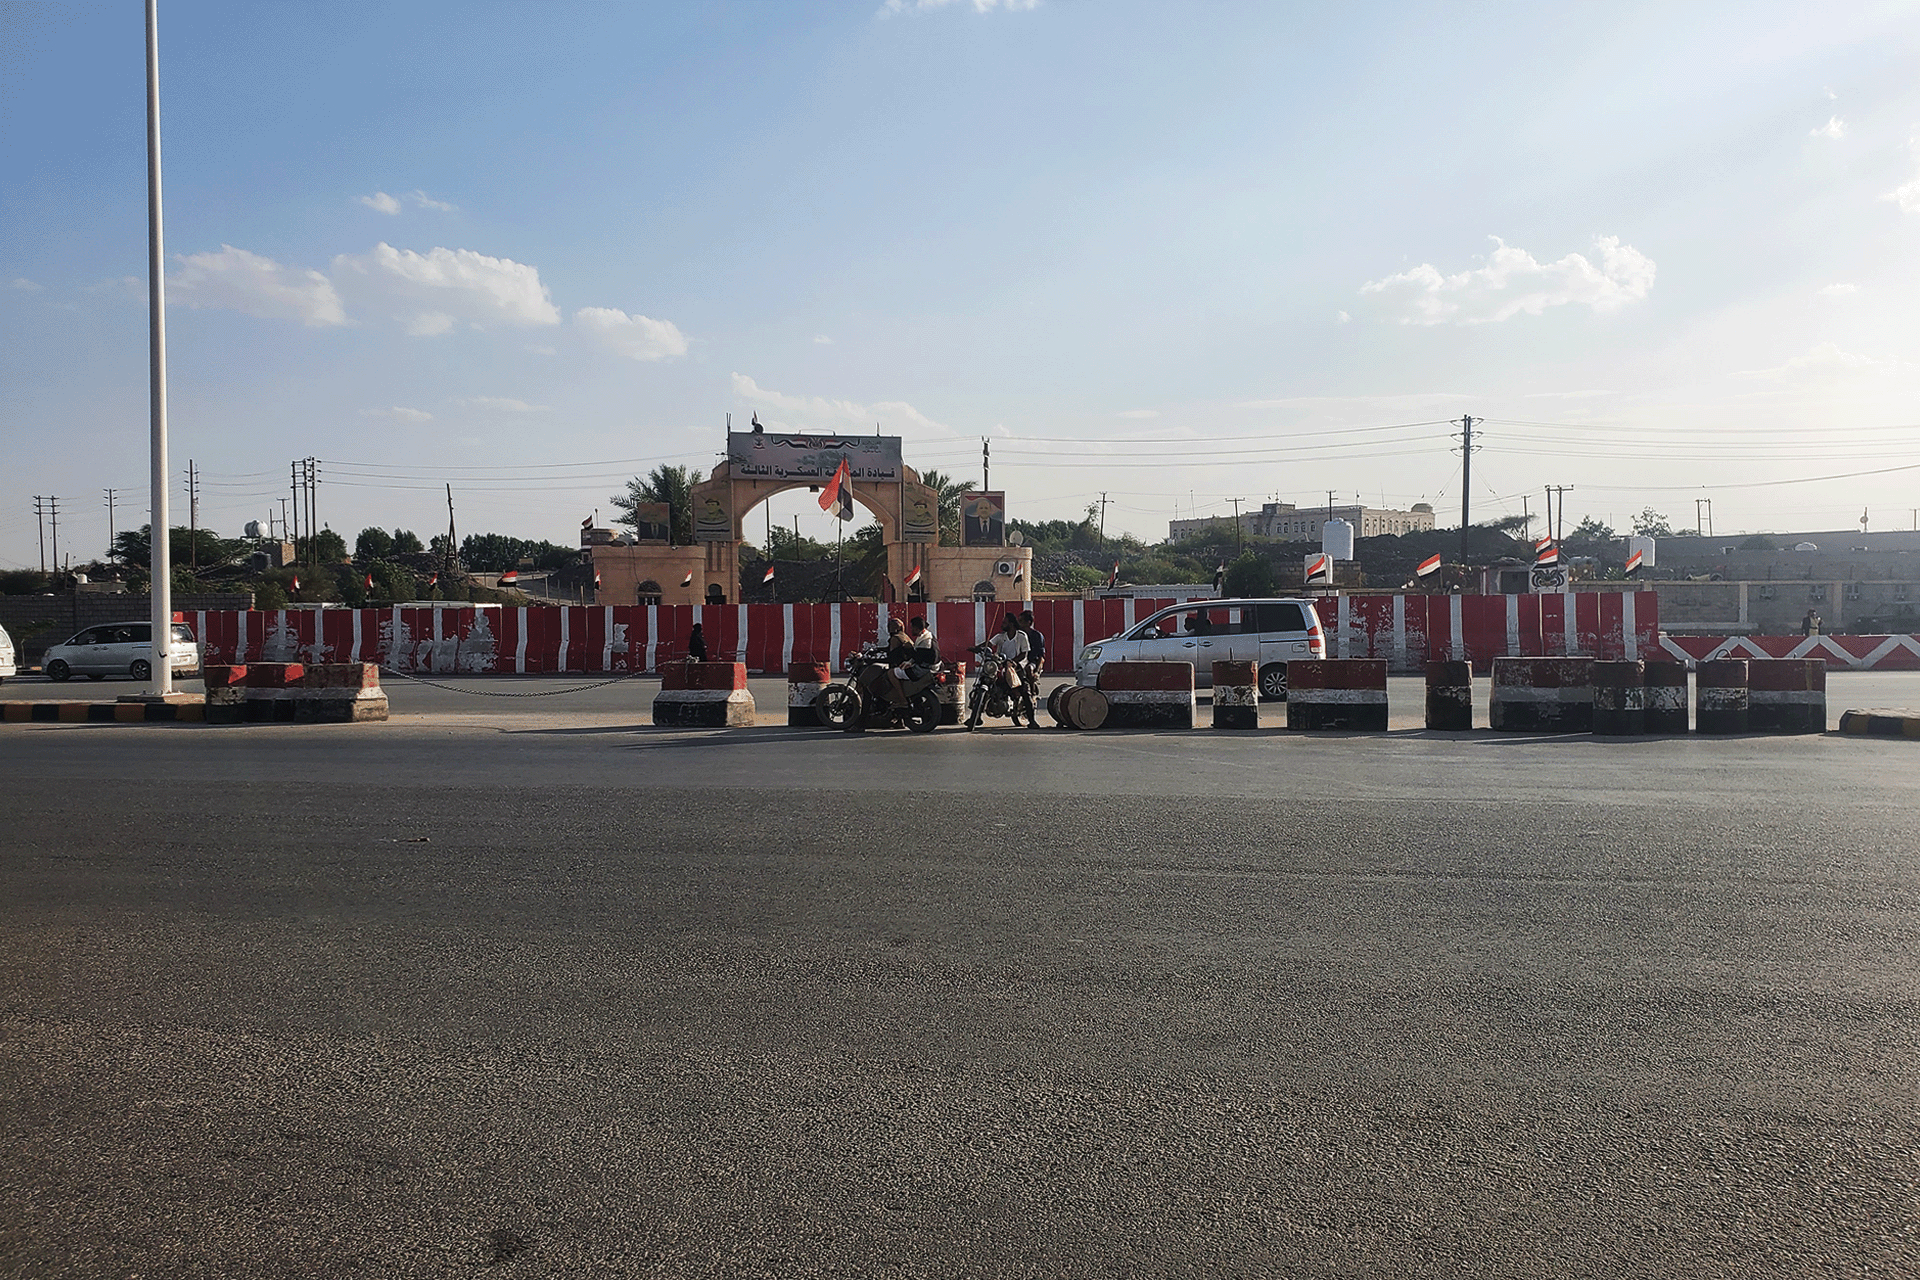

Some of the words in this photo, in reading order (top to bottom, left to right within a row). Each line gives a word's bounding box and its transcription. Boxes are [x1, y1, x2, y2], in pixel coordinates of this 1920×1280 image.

[740, 464, 772, 475] الثالثة
[774, 465, 822, 478] العسكرية
[825, 466, 865, 477] المقة
[867, 467, 895, 480] قيادة
